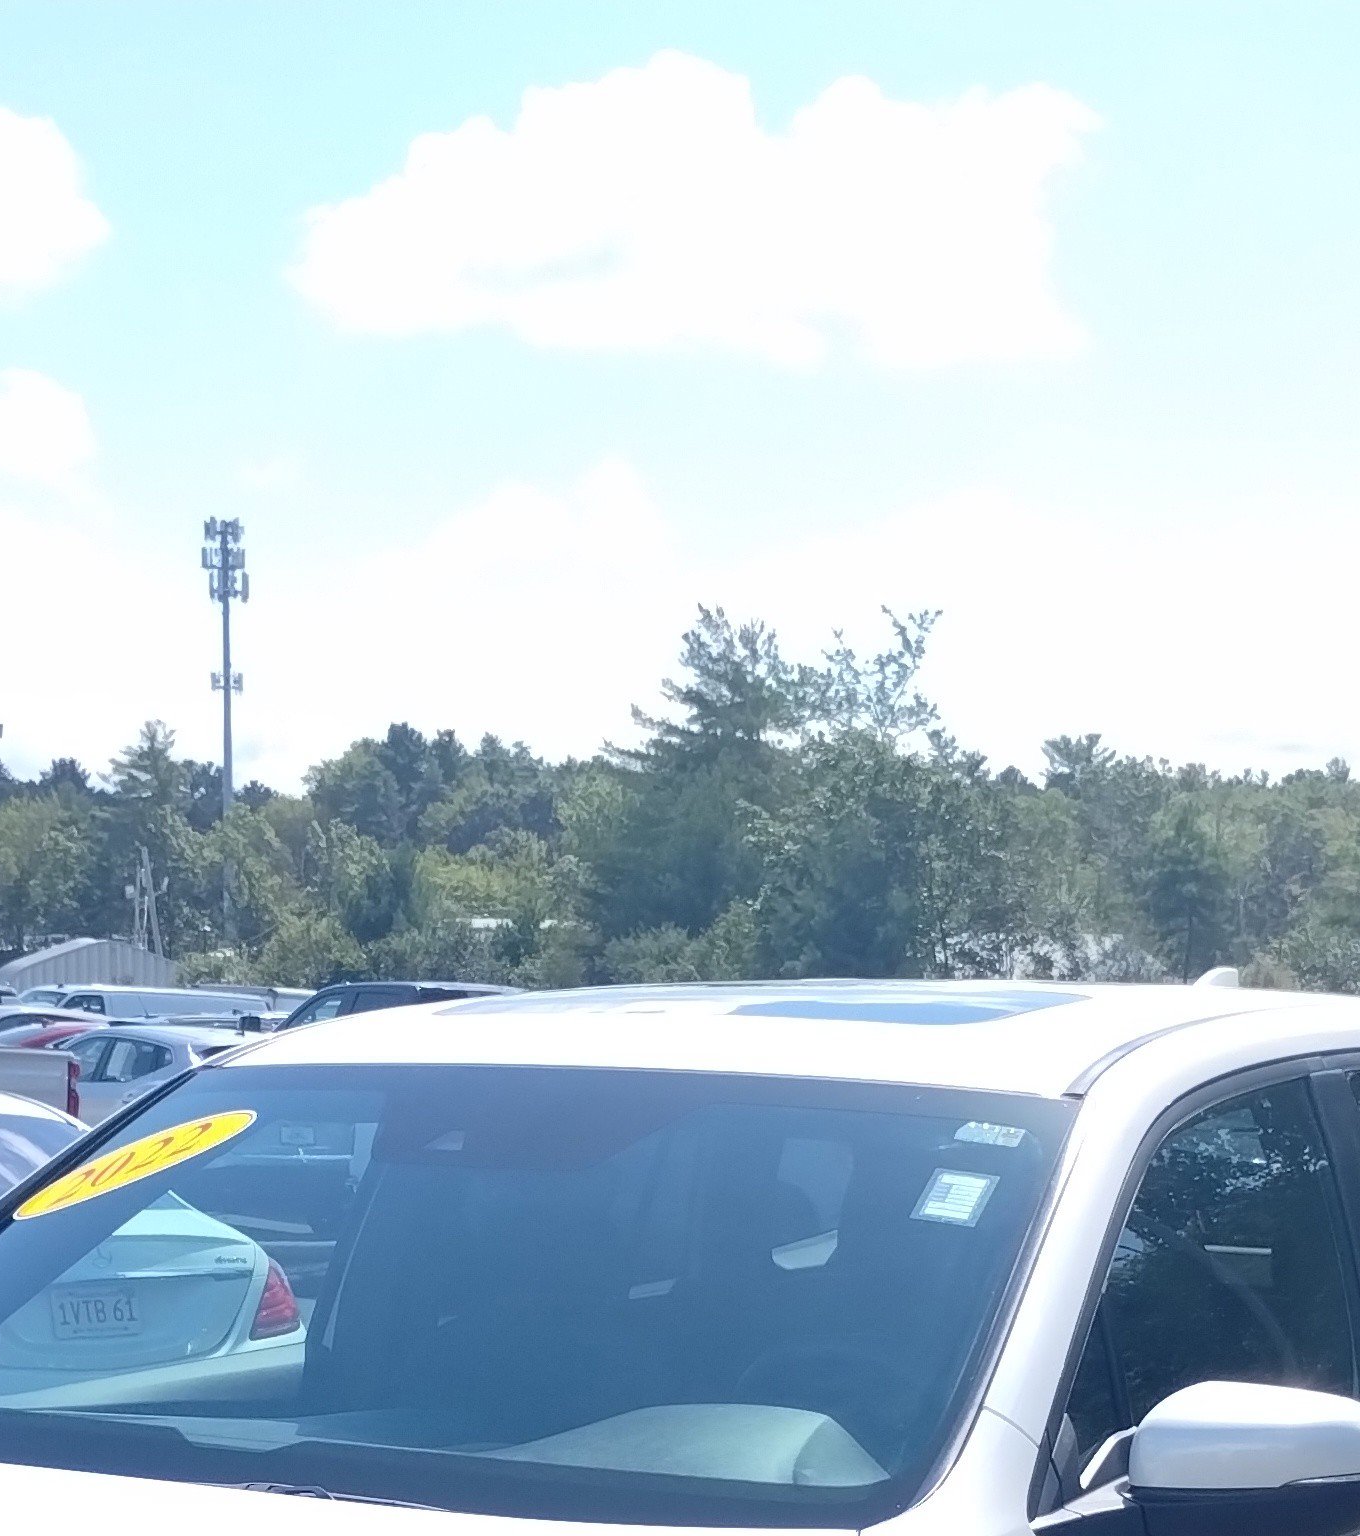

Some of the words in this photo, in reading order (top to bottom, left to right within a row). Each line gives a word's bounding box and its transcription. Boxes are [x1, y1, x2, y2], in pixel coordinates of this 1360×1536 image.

[42, 1122, 213, 1208] 2022
[59, 1300, 107, 1326] 1VTB
[113, 1298, 138, 1322] 61
